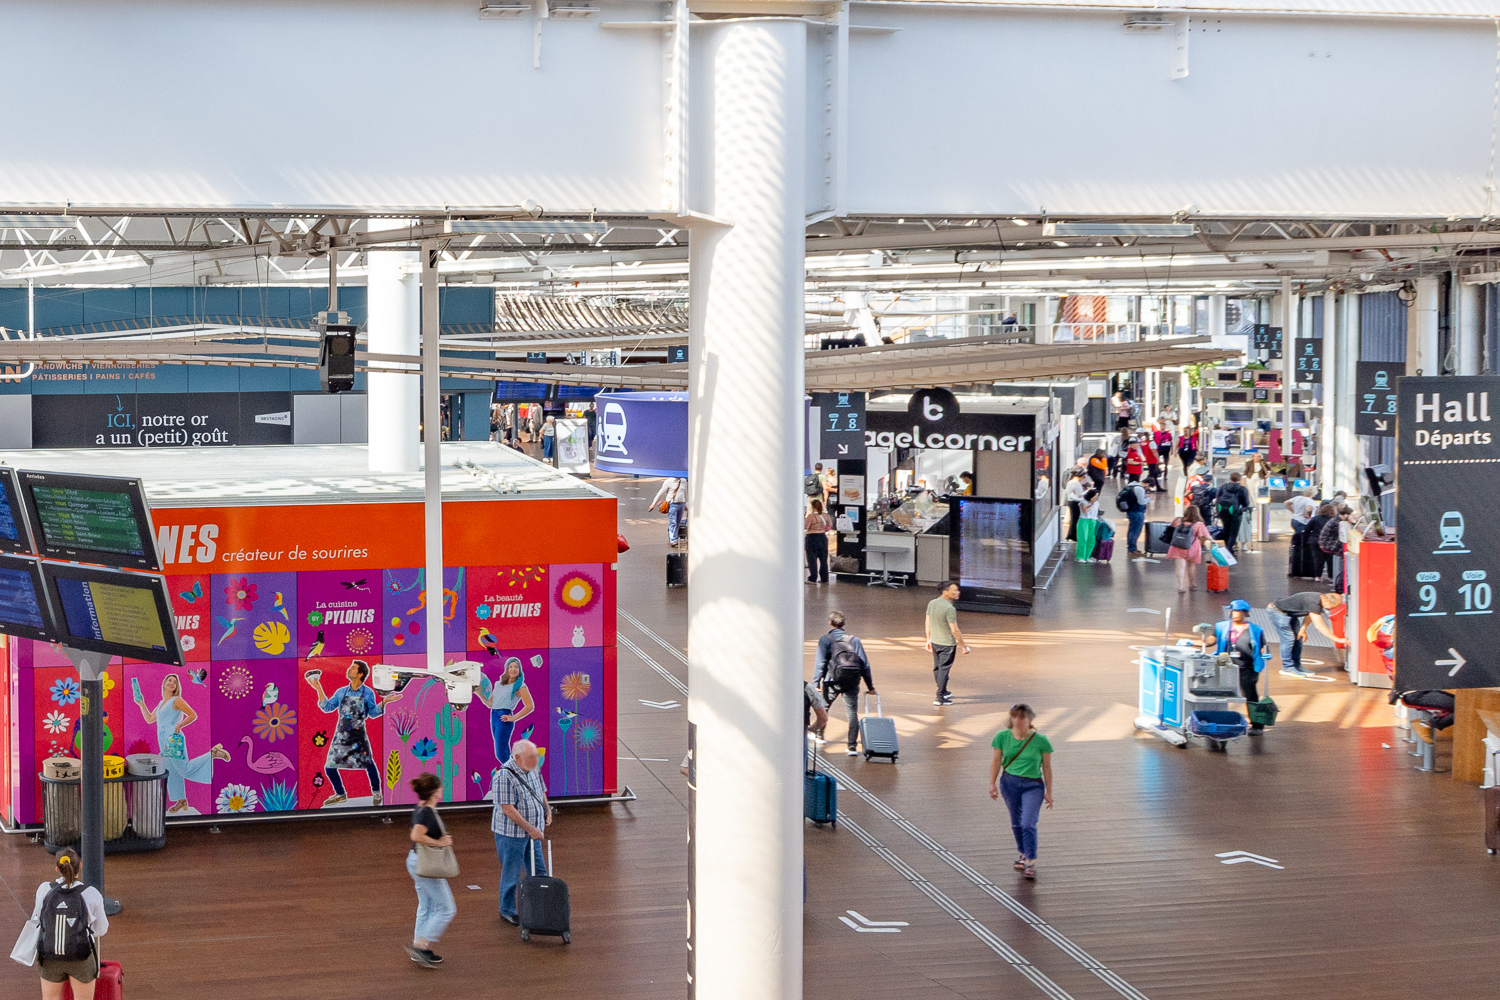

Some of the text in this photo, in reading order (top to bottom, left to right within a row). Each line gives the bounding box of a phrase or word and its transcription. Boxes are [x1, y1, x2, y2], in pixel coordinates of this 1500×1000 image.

[33, 361, 156, 370] SANDWICHS VIENNOISERIES
[32, 371, 156, 381] PÂTISSERIES PAINS CAFÉS
[1364, 400, 1397, 413] 7 8
[1415, 392, 1492, 423] Hall
[107, 413, 209, 430] ICI, notre or
[829, 418, 857, 430] 7 8
[95, 428, 229, 447] a un (petit) goût
[864, 425, 1032, 454] agelcorner
[1415, 429, 1492, 450] Départs
[222, 545, 368, 562] créateur de sourires
[1419, 571, 1484, 581] Voie Voie
[316, 600, 358, 609] La cuisine
[484, 593, 523, 602] La beauté
[1419, 583, 1492, 612] 9 10
[81, 581, 103, 640] information
[324, 608, 375, 626] PYLONES
[492, 602, 542, 619] PYLONES
